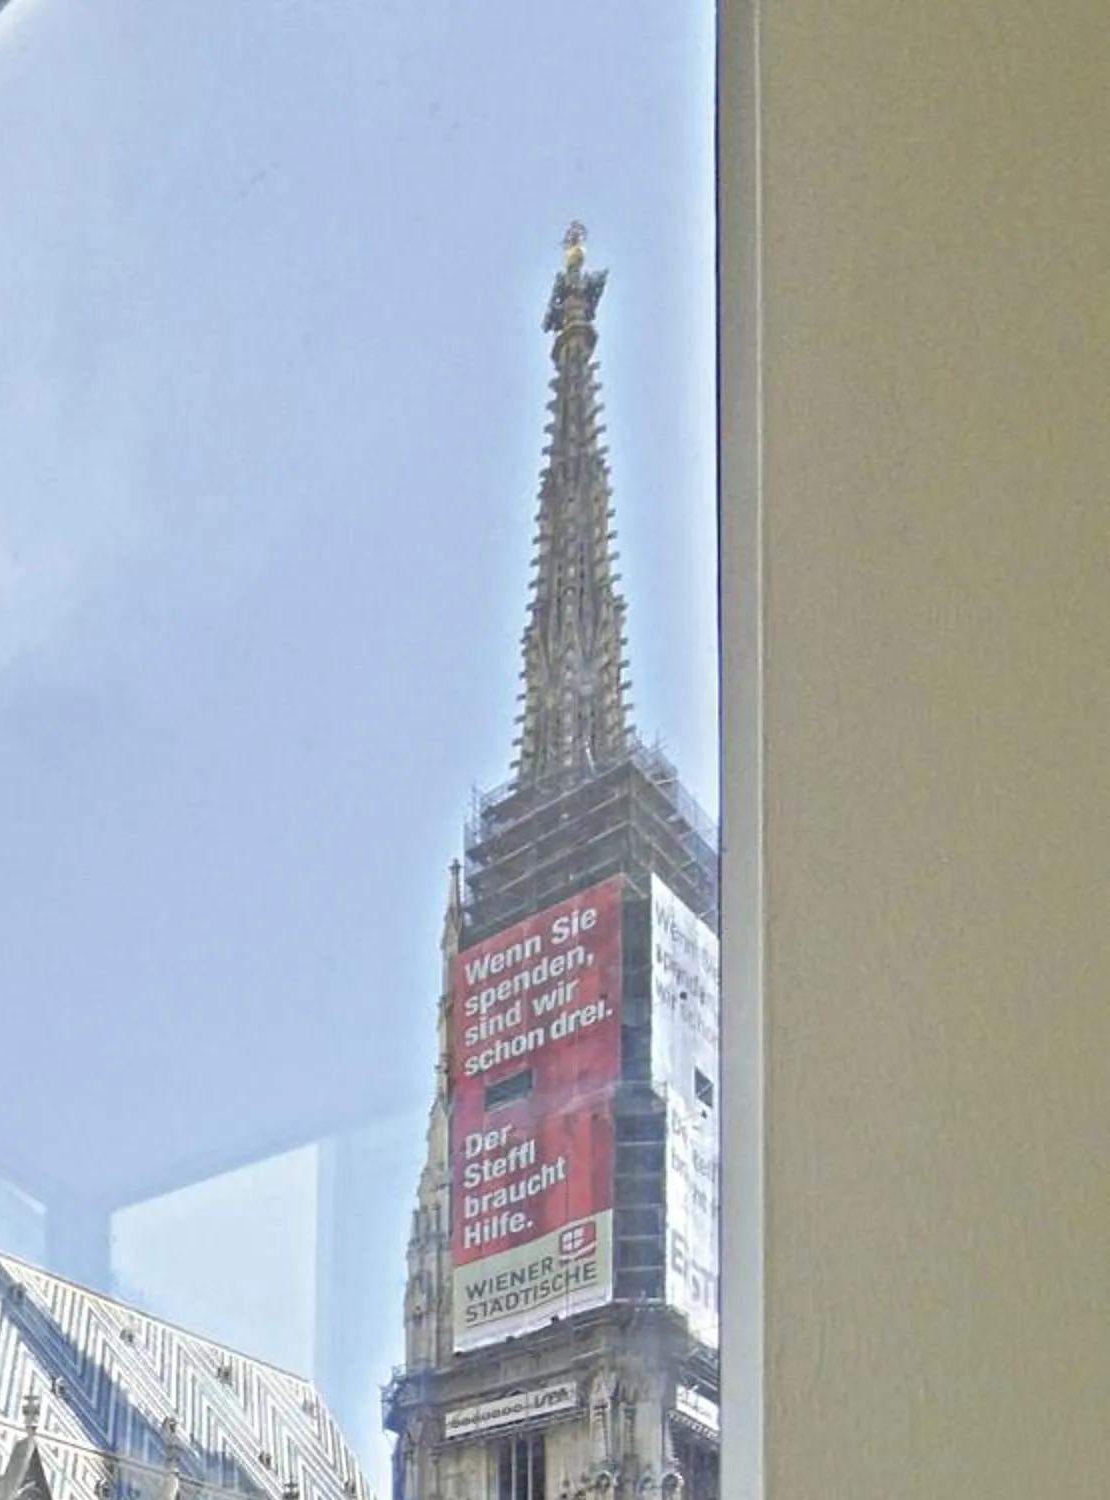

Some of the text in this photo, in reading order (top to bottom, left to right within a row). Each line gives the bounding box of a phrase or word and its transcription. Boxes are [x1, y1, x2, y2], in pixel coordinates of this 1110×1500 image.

[464, 907, 597, 985] Wenn Sie
[464, 945, 595, 1017] spenden,
[464, 978, 581, 1046] sind wir
[464, 1026, 545, 1076] schon
[462, 1138, 536, 1189] Steffl
[464, 1123, 513, 1160] Der
[463, 1155, 566, 1219] braucht
[462, 1209, 534, 1249] Hilfe.
[465, 1256, 554, 1301] WIENER
